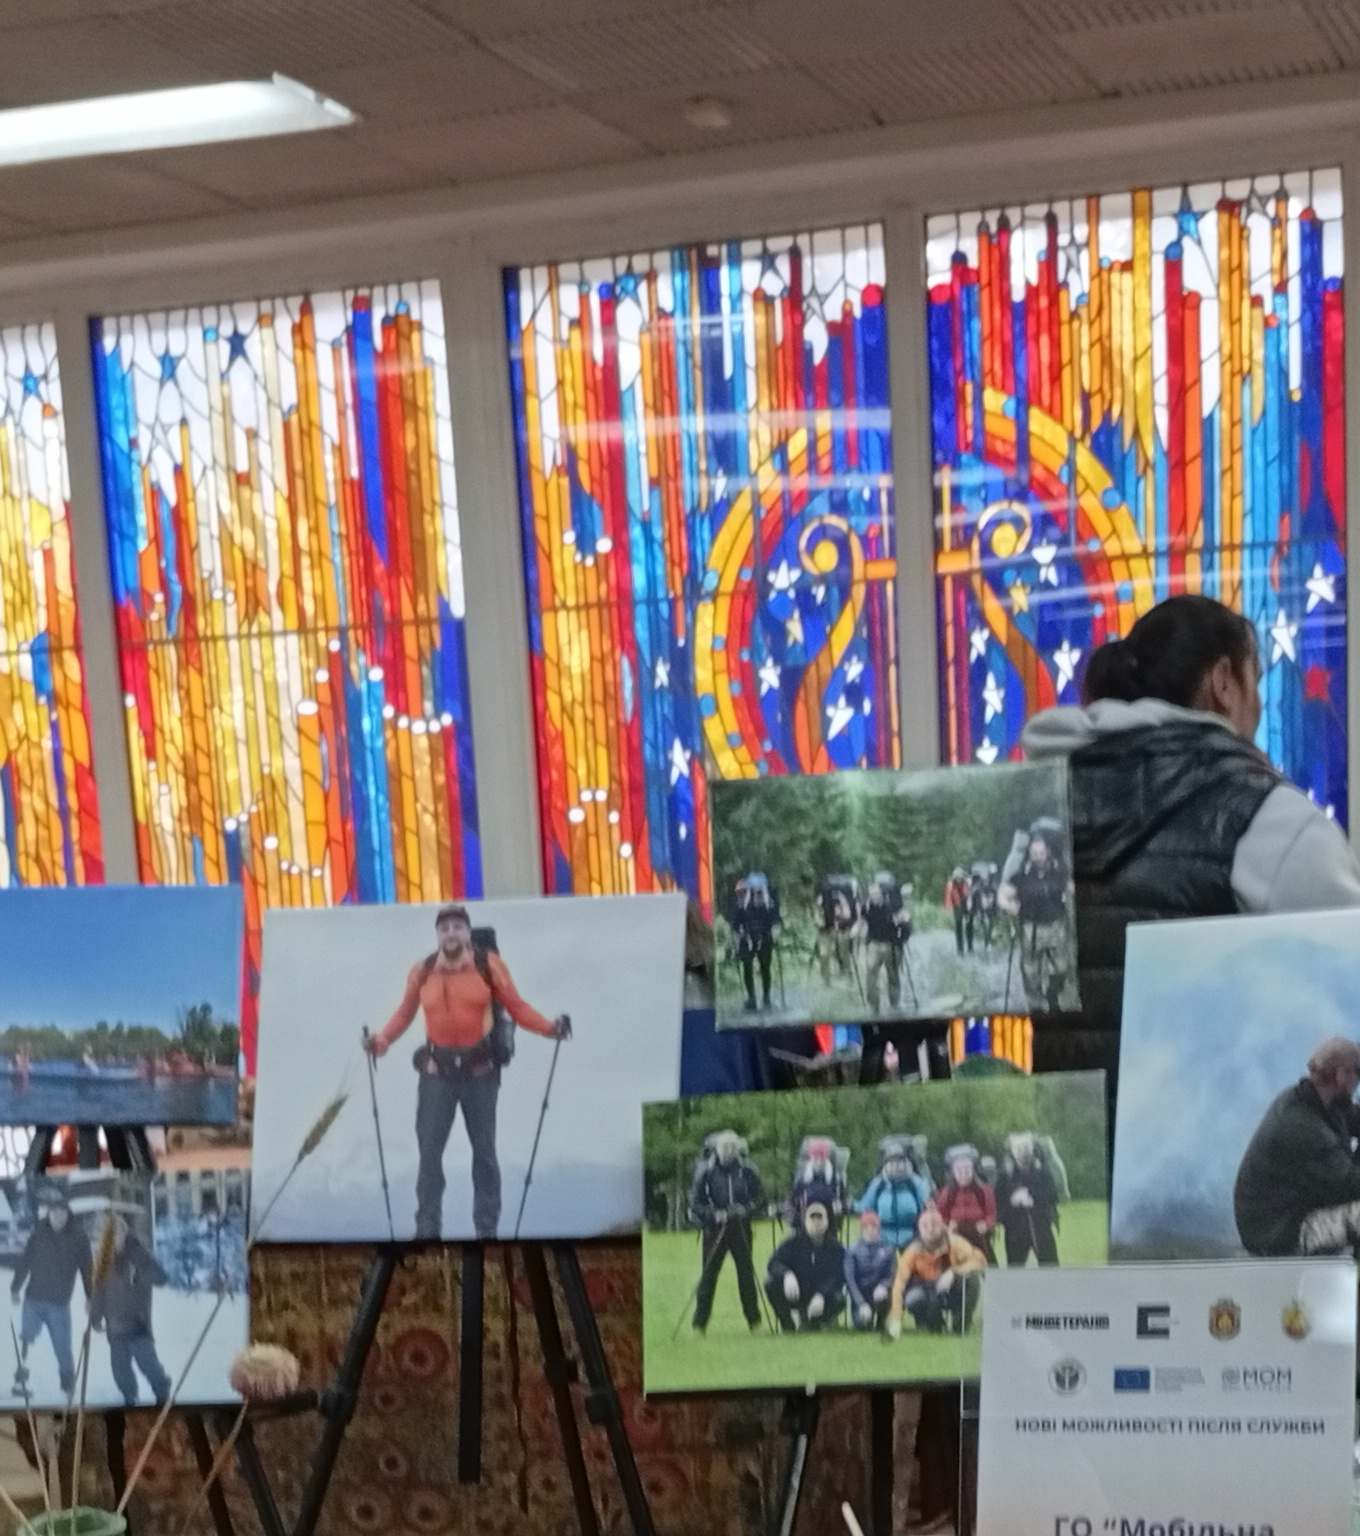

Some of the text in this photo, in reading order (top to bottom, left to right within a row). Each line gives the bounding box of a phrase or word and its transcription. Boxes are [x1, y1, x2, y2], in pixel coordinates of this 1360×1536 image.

[1015, 1417, 1325, 1436] НОВІ МОЖЛИВОСТІ ПІСЛЯ СЛУЖБИ
